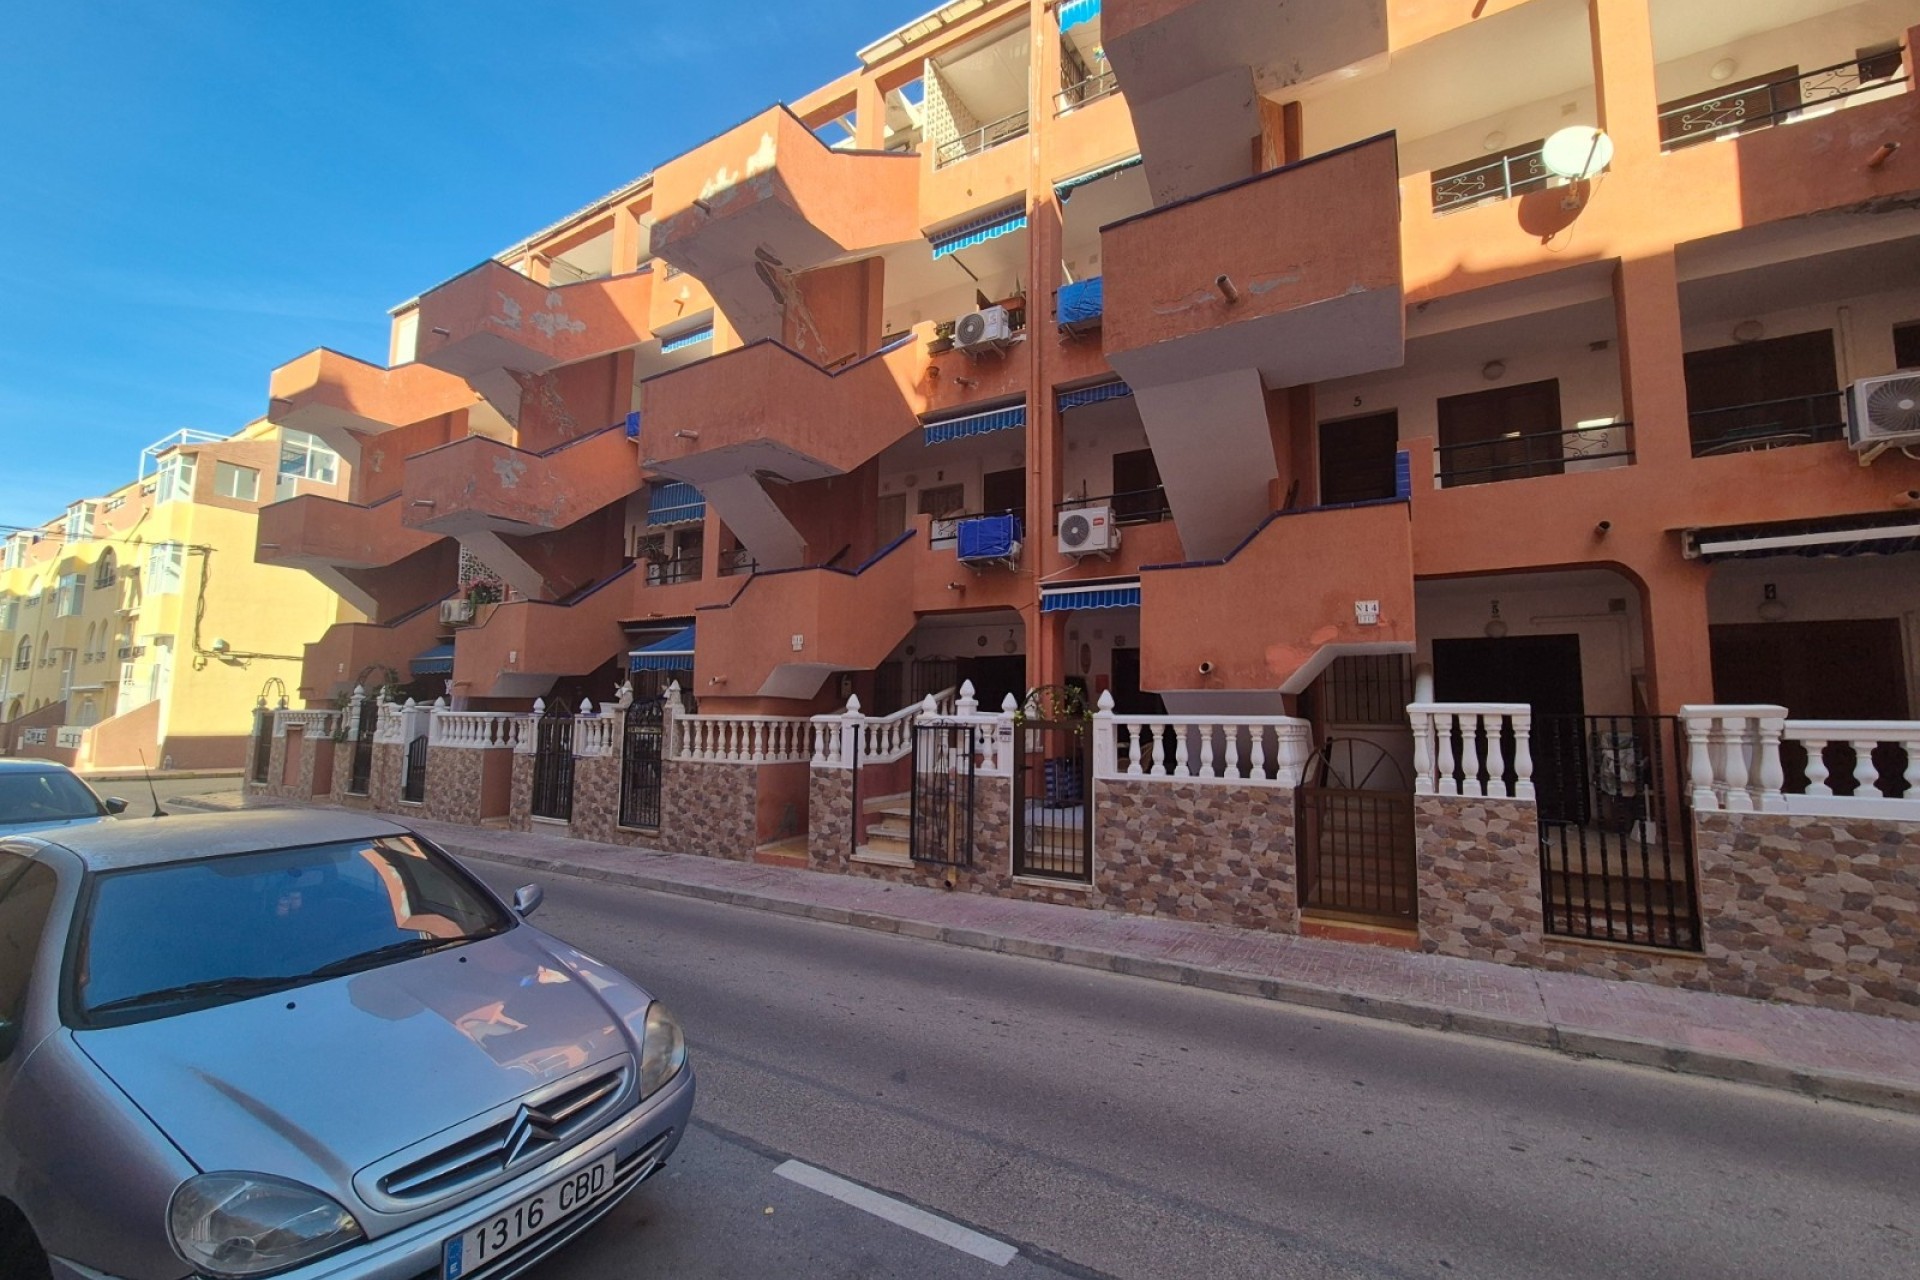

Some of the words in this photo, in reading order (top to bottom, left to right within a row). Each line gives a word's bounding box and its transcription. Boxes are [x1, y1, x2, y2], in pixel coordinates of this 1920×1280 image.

[1353, 395, 1362, 407] 5
[477, 1198, 545, 1259] 1316
[559, 1164, 604, 1211] CBD
[450, 1262, 458, 1274] E
